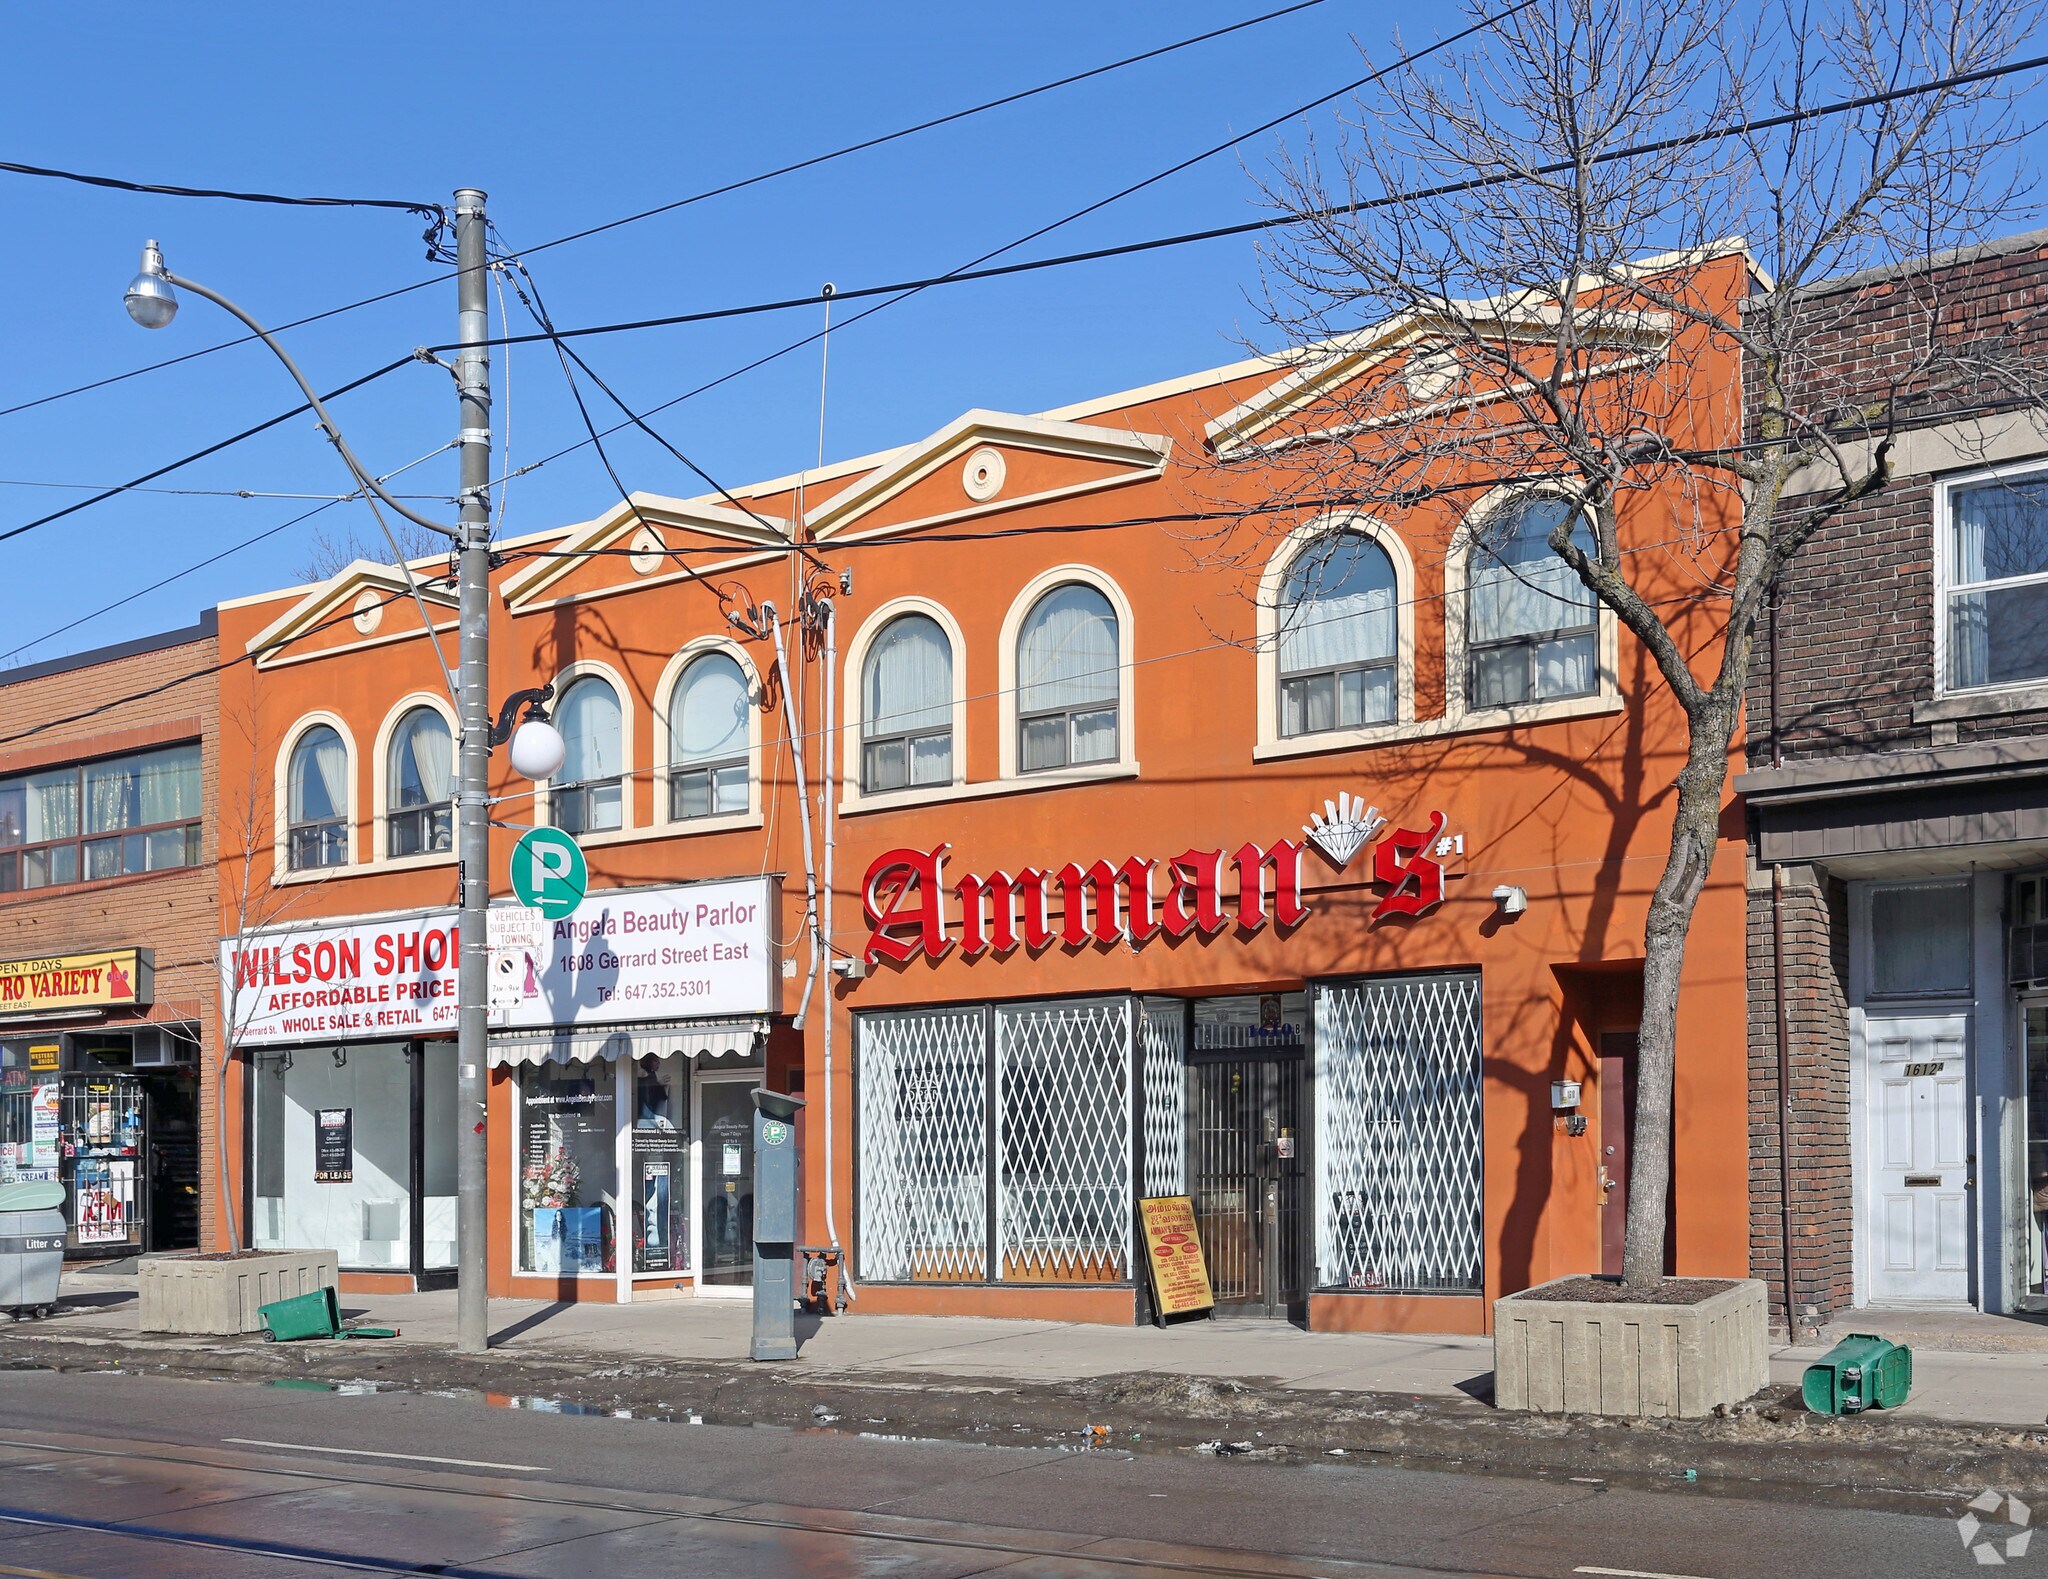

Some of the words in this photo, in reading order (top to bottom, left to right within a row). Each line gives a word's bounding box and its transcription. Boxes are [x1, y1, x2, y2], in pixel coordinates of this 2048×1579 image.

[1435, 834, 1465, 857] #1
[531, 840, 573, 892] P
[495, 911, 535, 922] VEHICLES
[553, 912, 617, 943] Angela
[624, 908, 689, 936] Beauty
[696, 901, 757, 927] Parlor
[490, 923, 526, 933] SUBJECT
[531, 923, 540, 932] TO
[500, 934, 532, 944] TOWING
[23, 962, 28, 972] 7
[32, 960, 62, 971] DAYS
[232, 938, 361, 989] WILSON
[374, 928, 460, 976] SHO
[560, 955, 594, 973] 1608
[599, 948, 656, 970] Gerrard
[661, 945, 708, 964] Street
[713, 942, 748, 961] East
[30, 968, 102, 998] VARIETY
[597, 986, 620, 1002] Tel:
[625, 980, 712, 1000] 647.352.5301
[268, 985, 390, 1011] AFFORDABLE
[244, 1027, 268, 1036] Gerrard
[282, 1016, 325, 1033] WHOLE
[329, 1013, 361, 1030] SALE
[364, 1015, 373, 1026] &
[377, 1009, 422, 1026] RETAIL
[21, 1172, 43, 1181] CREAM
[315, 1172, 328, 1180] FOR
[330, 1171, 352, 1180] LEASE
[1151, 1225, 1171, 1235] AMMAN'S
[1172, 1224, 1195, 1233] JEWELLERS
[27, 1240, 48, 1249] Litter
